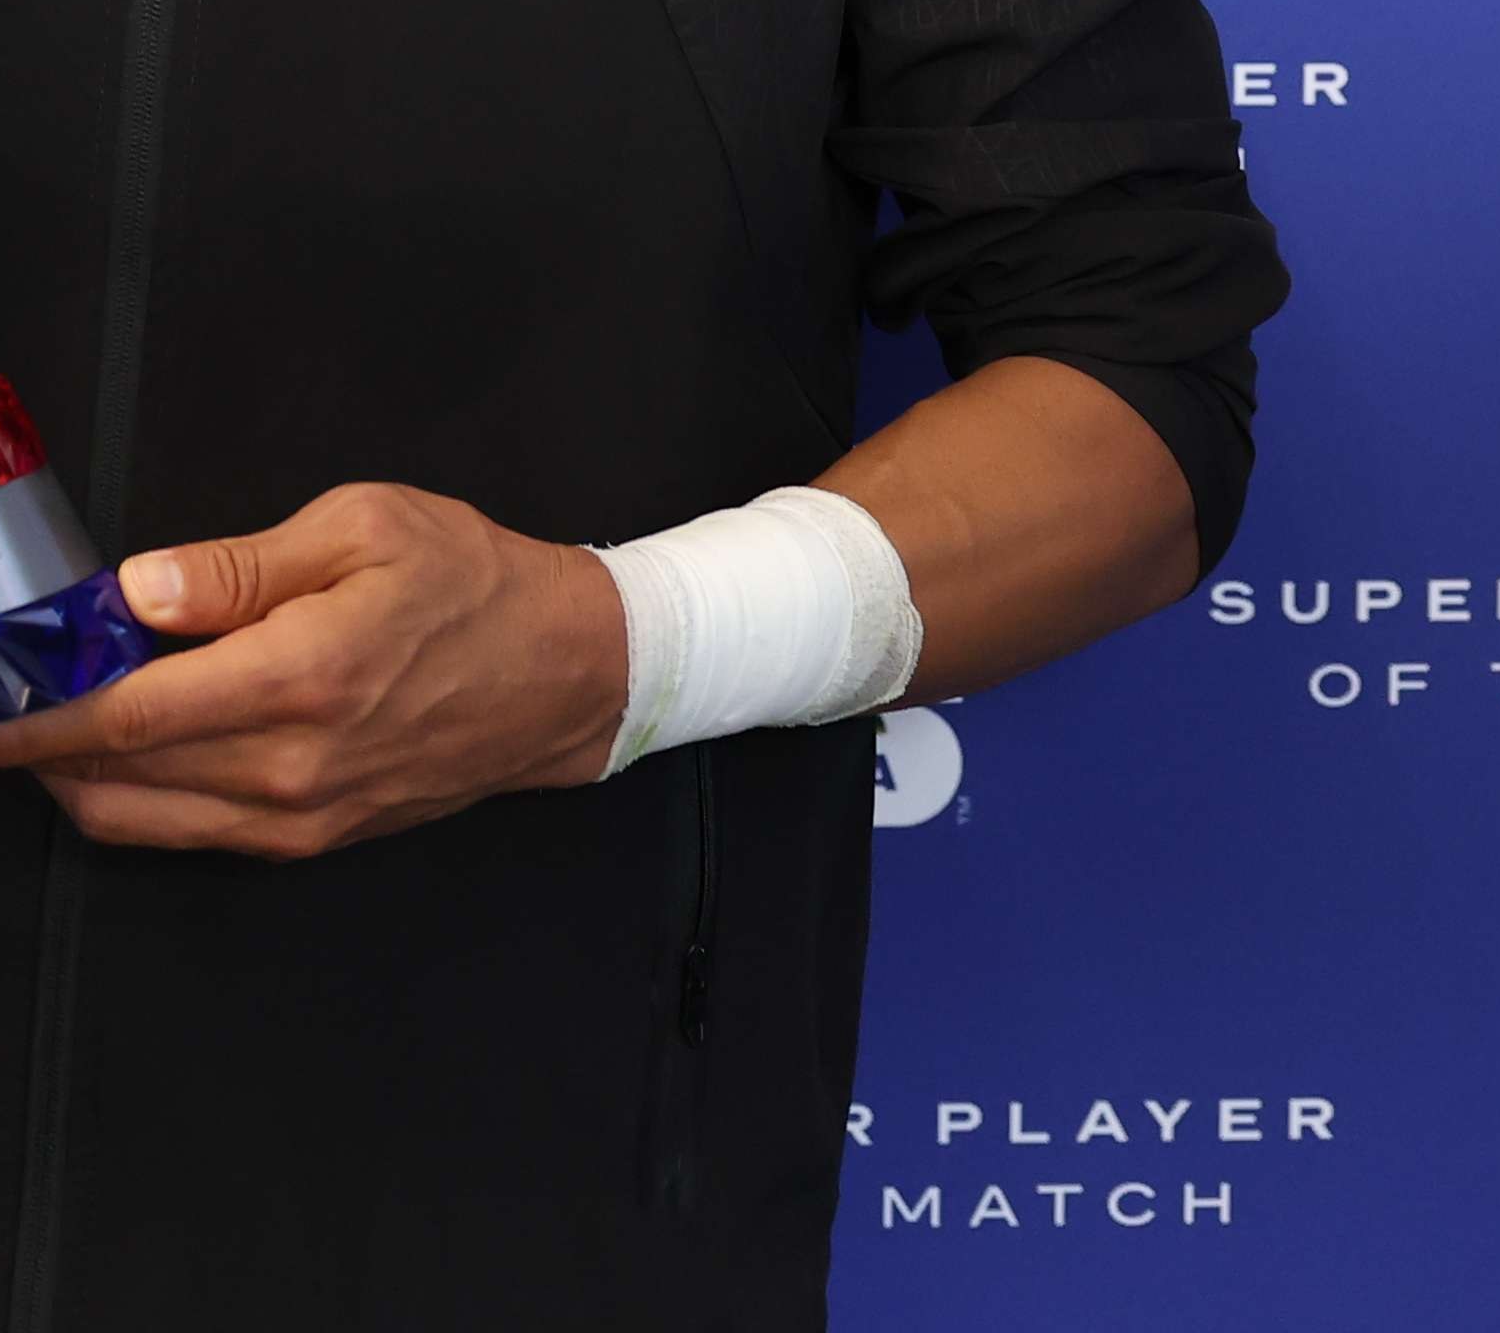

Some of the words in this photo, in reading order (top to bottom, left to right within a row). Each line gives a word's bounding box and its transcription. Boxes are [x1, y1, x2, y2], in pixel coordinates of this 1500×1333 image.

[1308, 662, 1432, 708] OF
[936, 1096, 1336, 1146] PLAYER
[881, 1181, 1232, 1230] MATCH
